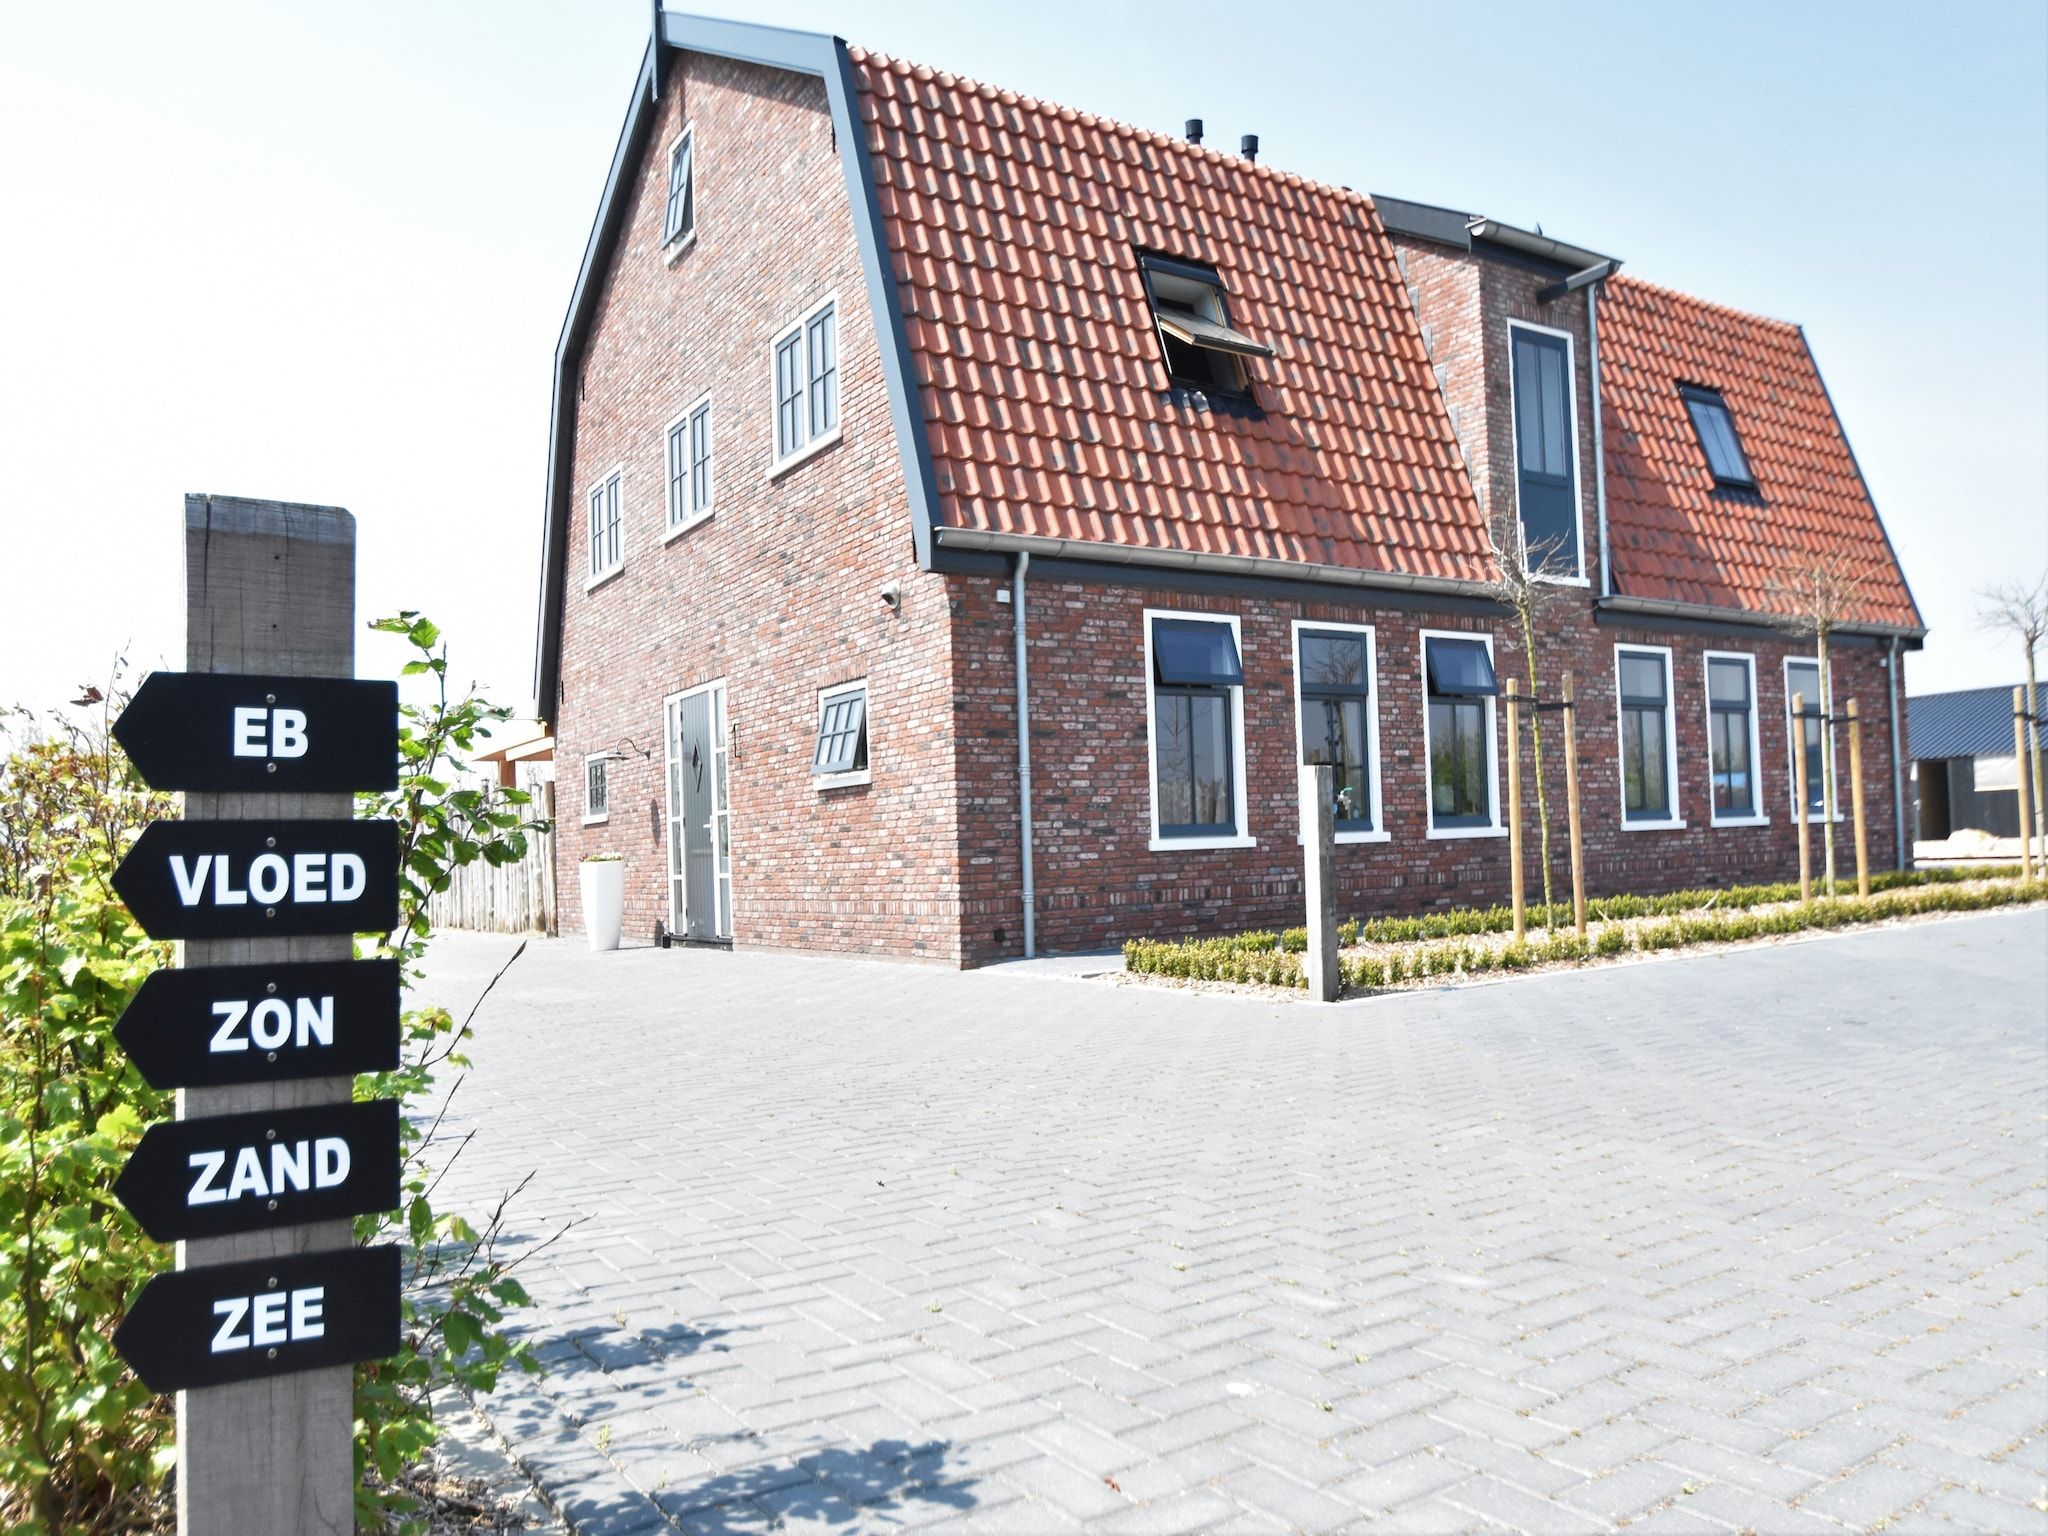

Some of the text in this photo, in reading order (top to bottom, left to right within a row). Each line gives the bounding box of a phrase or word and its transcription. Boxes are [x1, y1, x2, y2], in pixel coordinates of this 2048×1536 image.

[233, 707, 309, 758] EB
[169, 853, 366, 906] VLOED
[209, 996, 334, 1053] ZON
[187, 1137, 351, 1206] ZAND
[211, 1286, 325, 1353] ZEE
